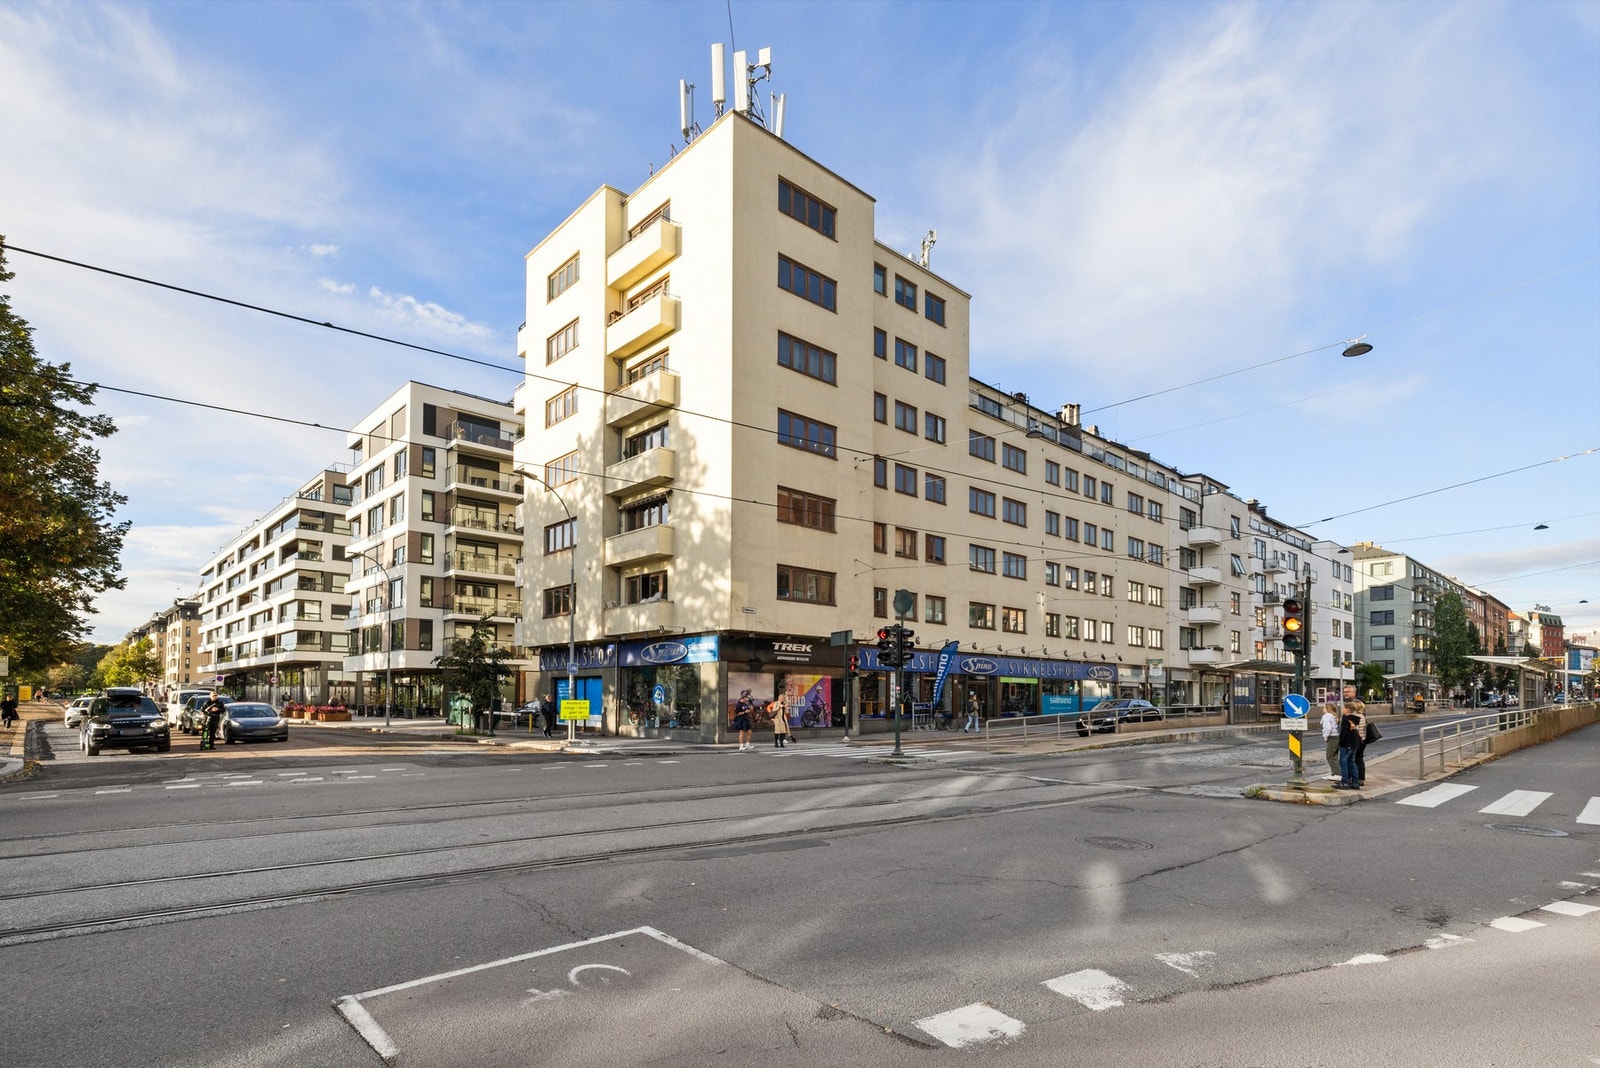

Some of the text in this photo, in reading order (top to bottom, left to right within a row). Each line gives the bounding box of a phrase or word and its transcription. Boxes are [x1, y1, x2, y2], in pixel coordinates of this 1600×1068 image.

[772, 642, 813, 652] TREK
[540, 648, 614, 668] SYKKLSHOP
[965, 658, 993, 672] Spinn
[1009, 661, 1077, 676] SYKKELSHOP
